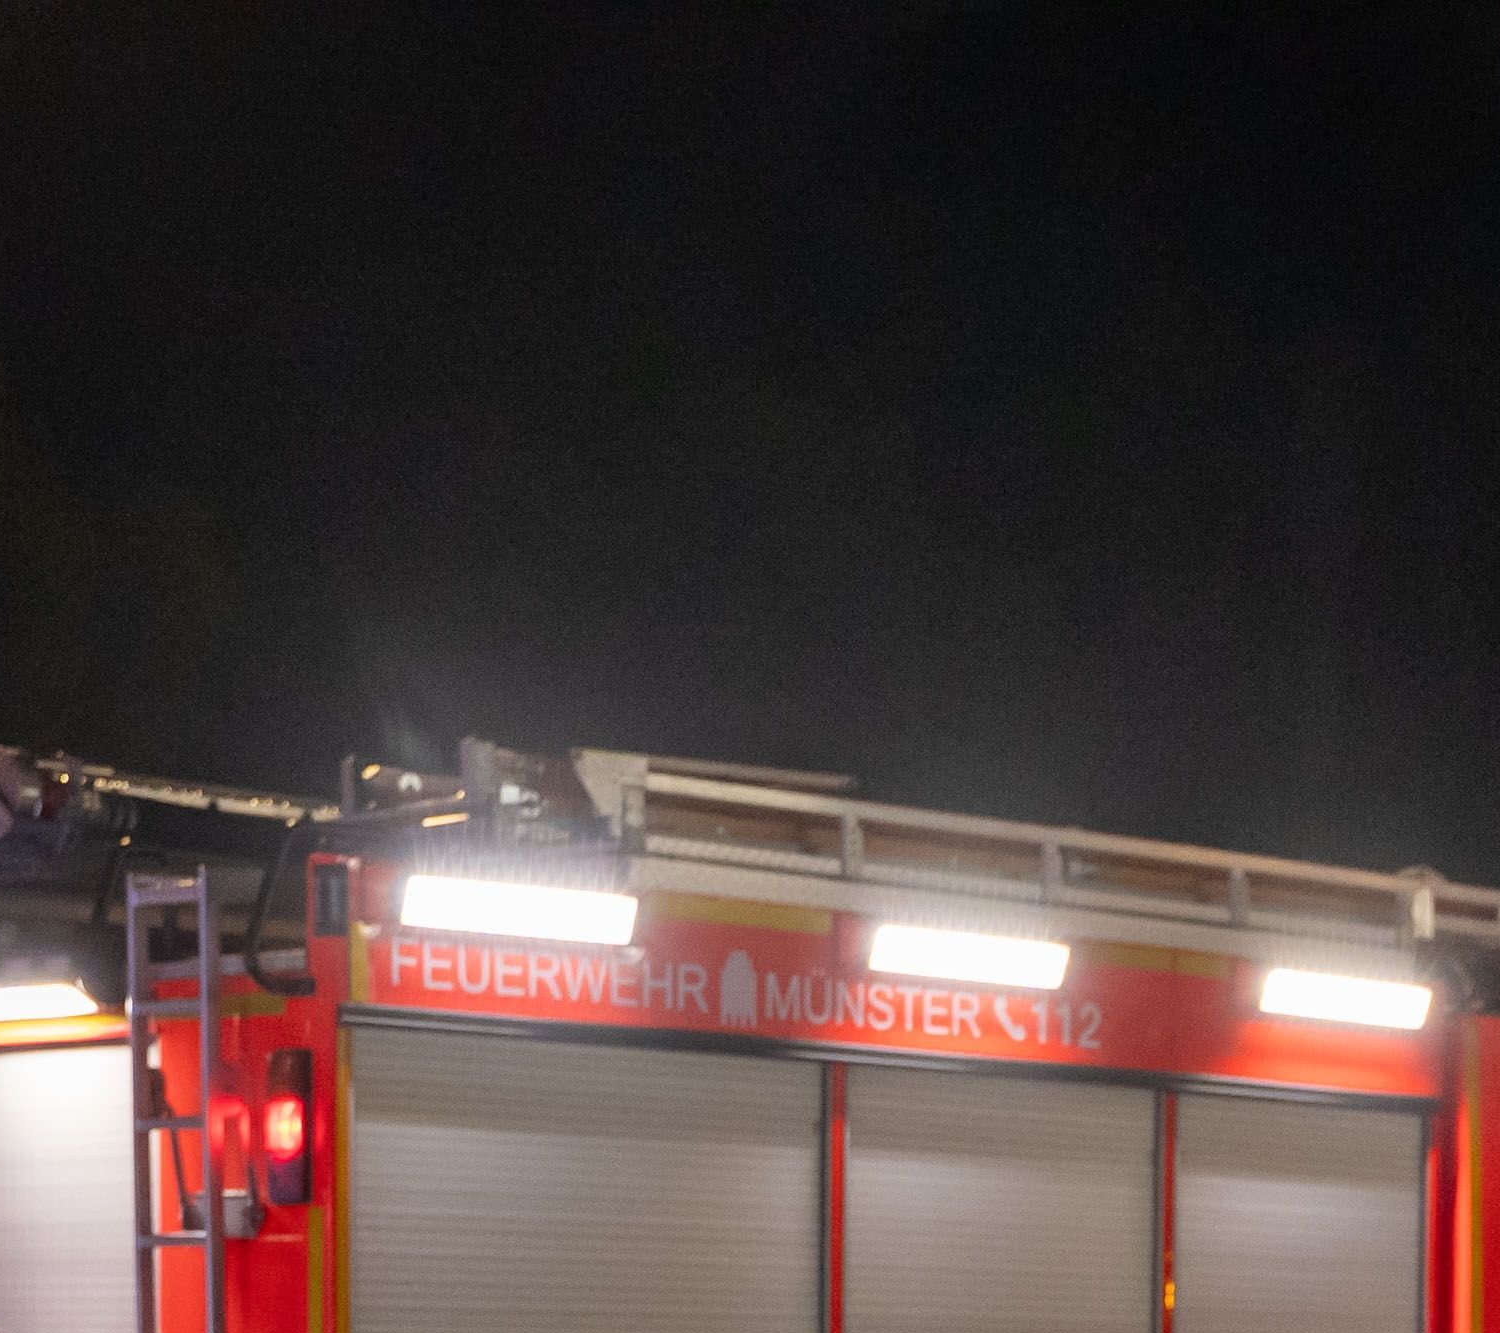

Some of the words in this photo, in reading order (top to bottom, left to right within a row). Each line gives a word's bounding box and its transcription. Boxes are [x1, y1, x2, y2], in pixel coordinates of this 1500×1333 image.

[390, 936, 709, 1014] FEUERWEHR
[764, 967, 981, 1040] MÜNSTER
[1032, 1001, 1101, 1050] 112
